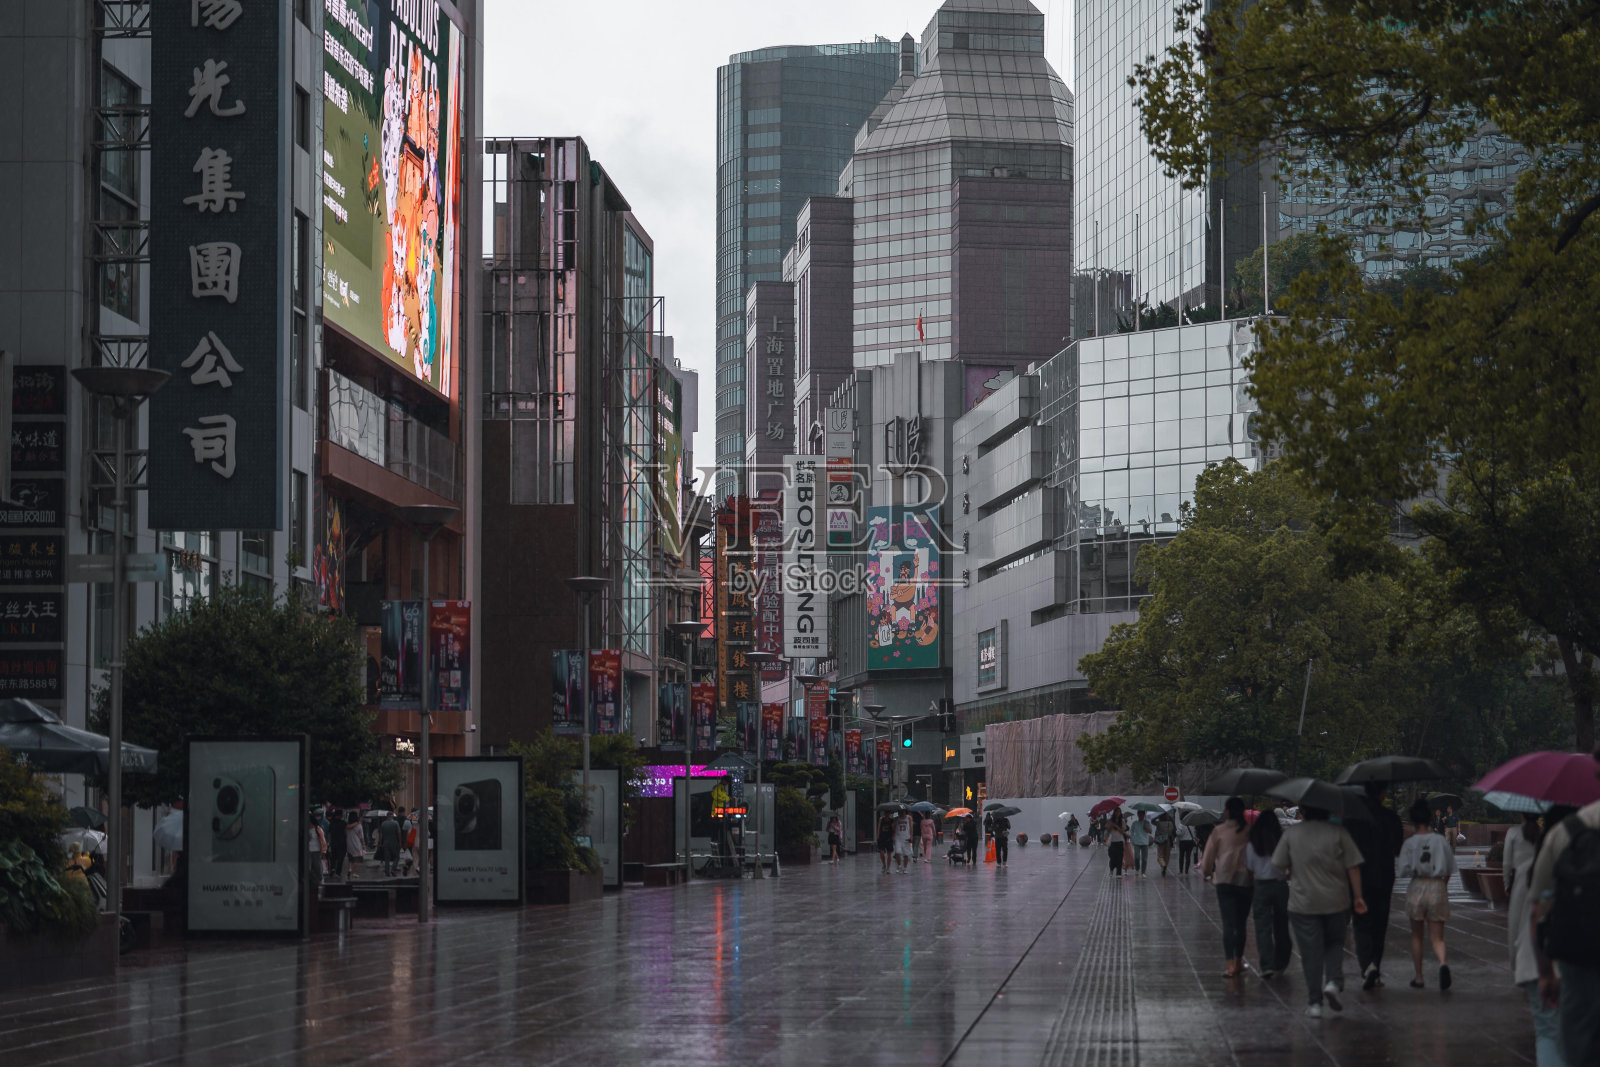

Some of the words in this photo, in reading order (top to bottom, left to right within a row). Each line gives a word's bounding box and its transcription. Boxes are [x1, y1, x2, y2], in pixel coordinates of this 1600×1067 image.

[390, 21, 438, 115] BEATS
[767, 315, 785, 440] 上海置地广场
[0, 600, 57, 619] 丝大王
[202, 884, 238, 893] HUAWEI
